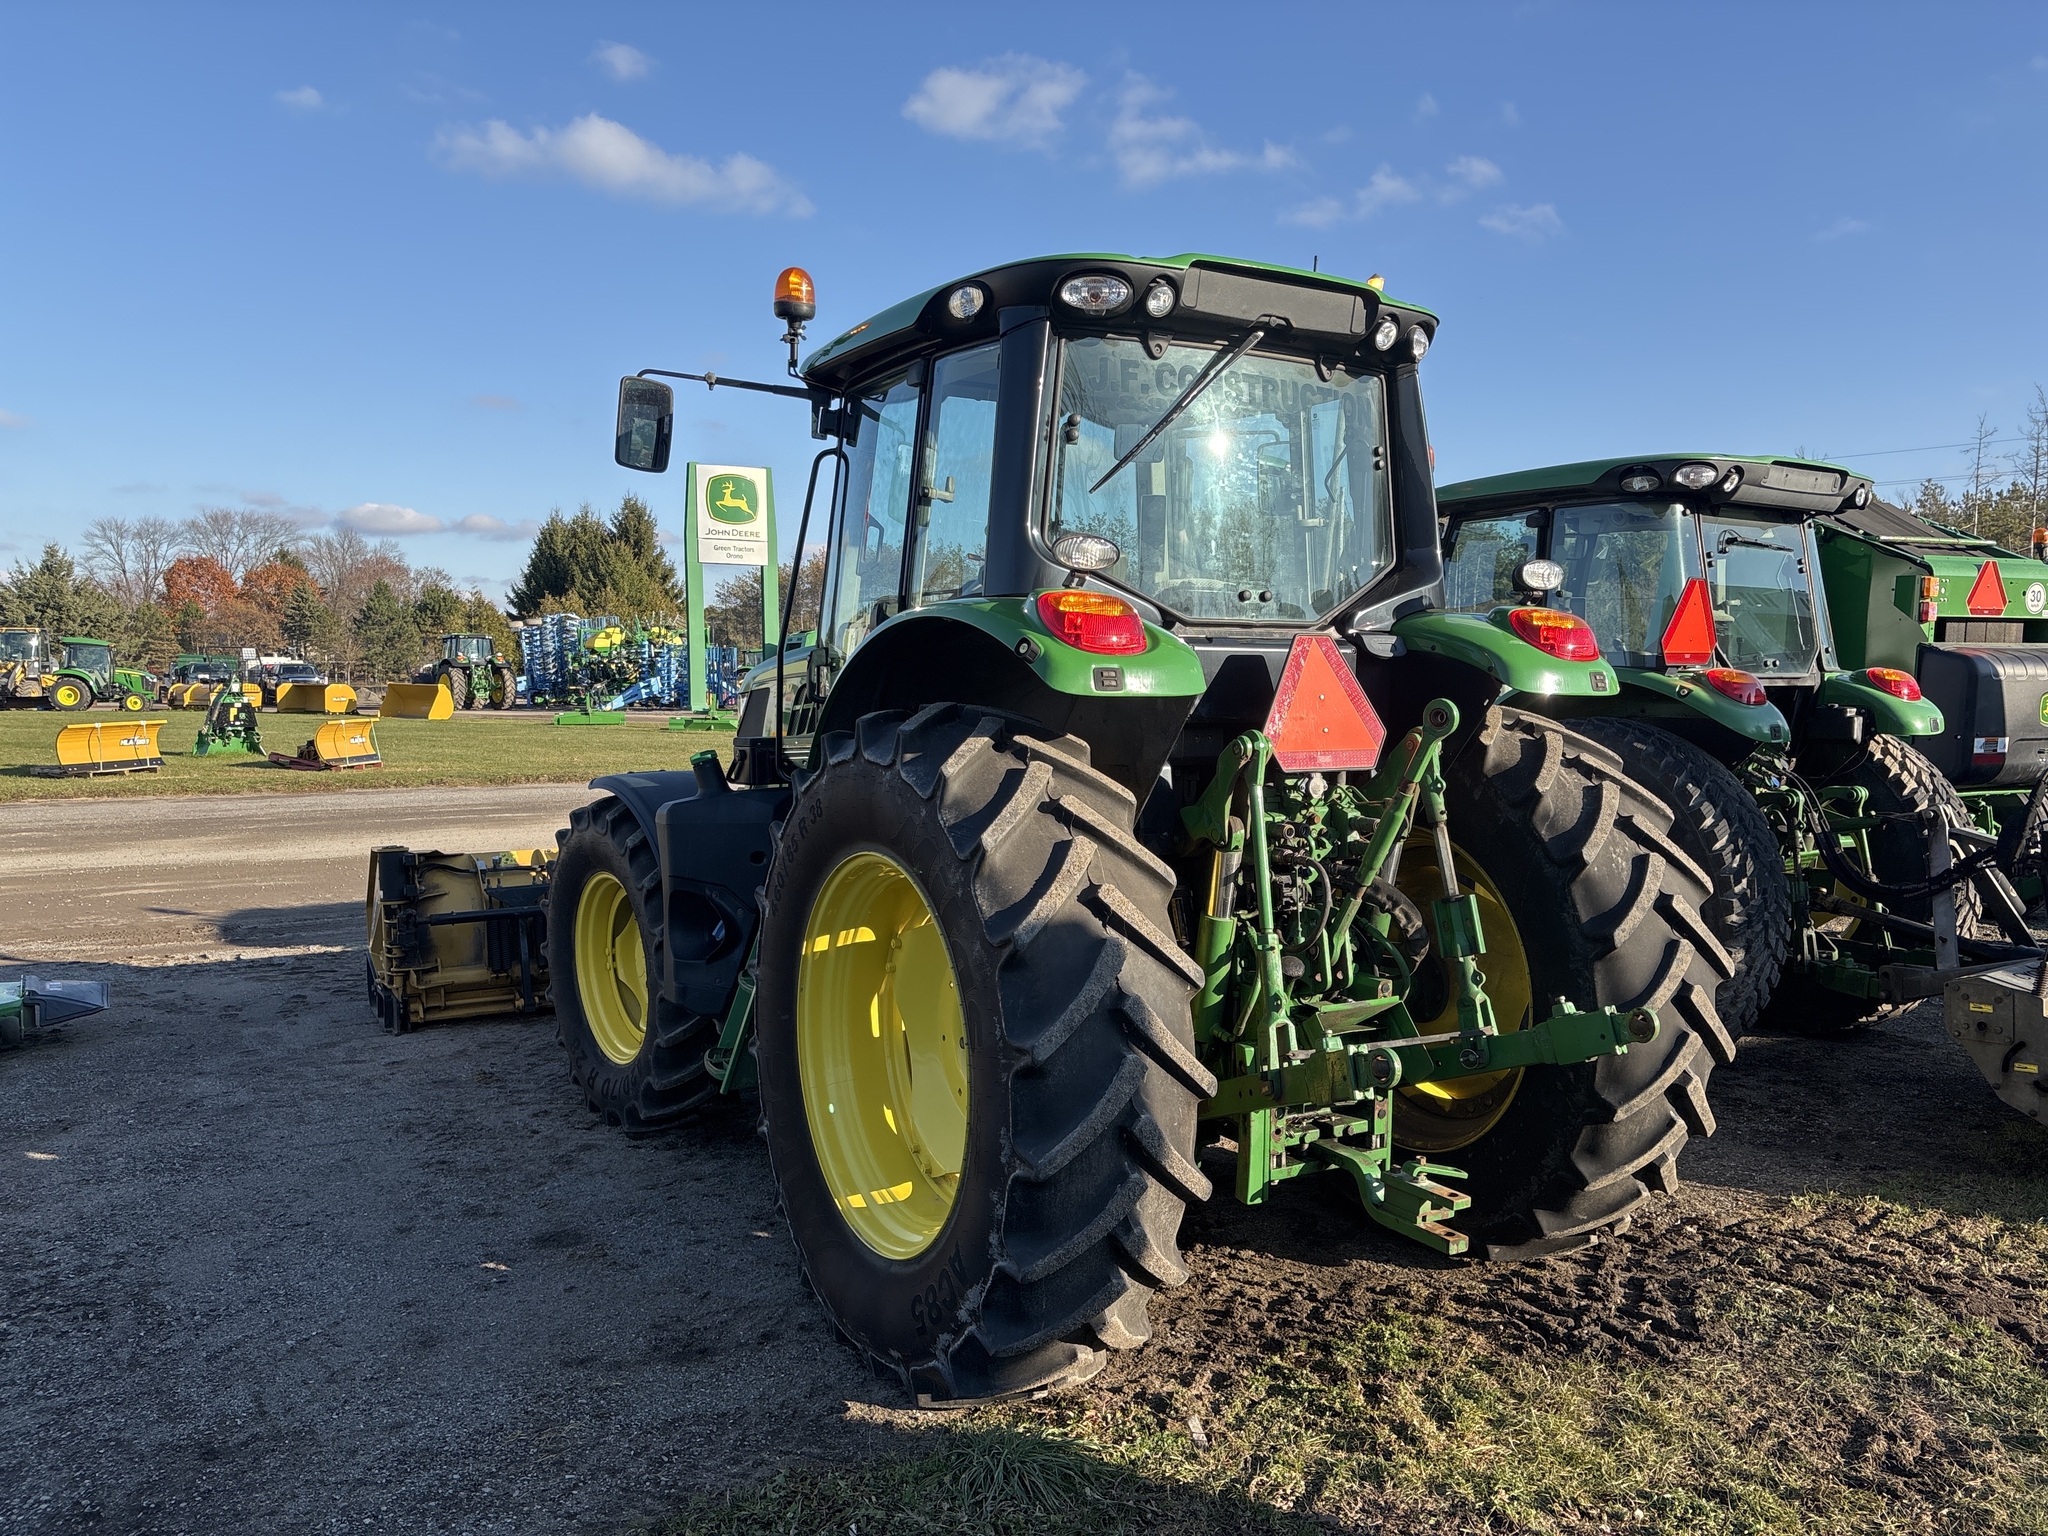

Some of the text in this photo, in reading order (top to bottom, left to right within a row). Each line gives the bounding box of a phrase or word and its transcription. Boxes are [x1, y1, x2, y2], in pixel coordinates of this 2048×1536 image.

[705, 528, 760, 538] JOHN DEERE
[733, 545, 755, 553] Tractors
[2030, 590, 2042, 602] 30
[799, 820, 808, 839] R
[809, 797, 823, 825] 38
[587, 1066, 599, 1091] R
[911, 1240, 969, 1337] AC85
